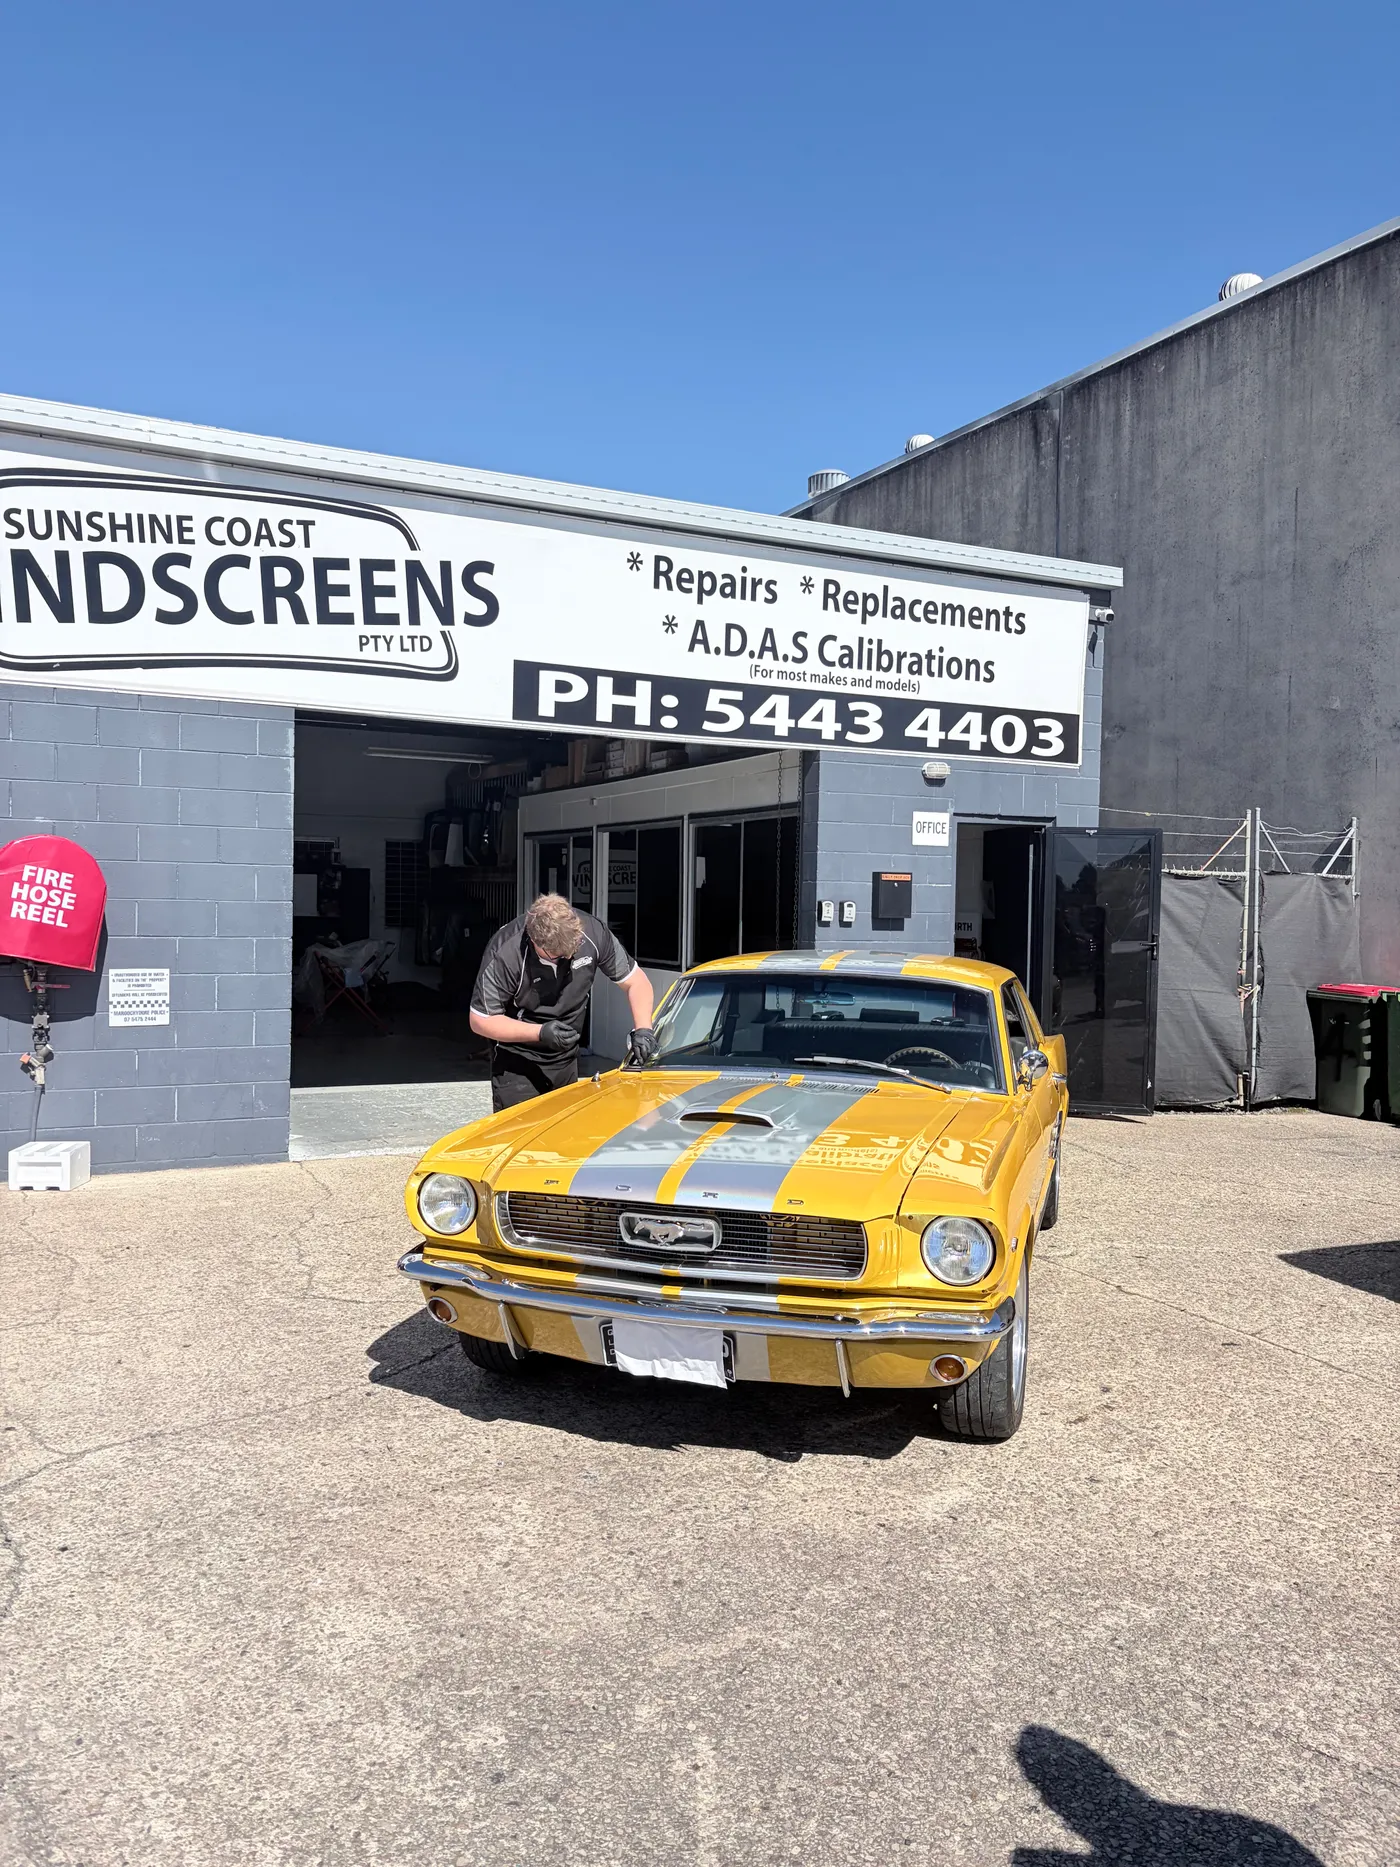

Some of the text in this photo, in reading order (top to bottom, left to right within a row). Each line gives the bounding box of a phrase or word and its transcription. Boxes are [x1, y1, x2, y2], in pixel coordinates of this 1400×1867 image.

[4, 508, 315, 548] SUNSHINE COAST
[0, 549, 499, 627] NDSCREENS
[654, 555, 1025, 634] Repairs Replacements
[359, 634, 432, 652] PTY LTD
[688, 620, 994, 683] A.D.A.S Calibrations
[749, 664, 921, 694] (For most makes and models)
[538, 671, 1064, 756] PH: 5443 4403
[916, 821, 947, 834] OFFICE
[22, 865, 74, 890] FIRE
[11, 882, 77, 910] HOSE
[10, 901, 68, 928] REEL
